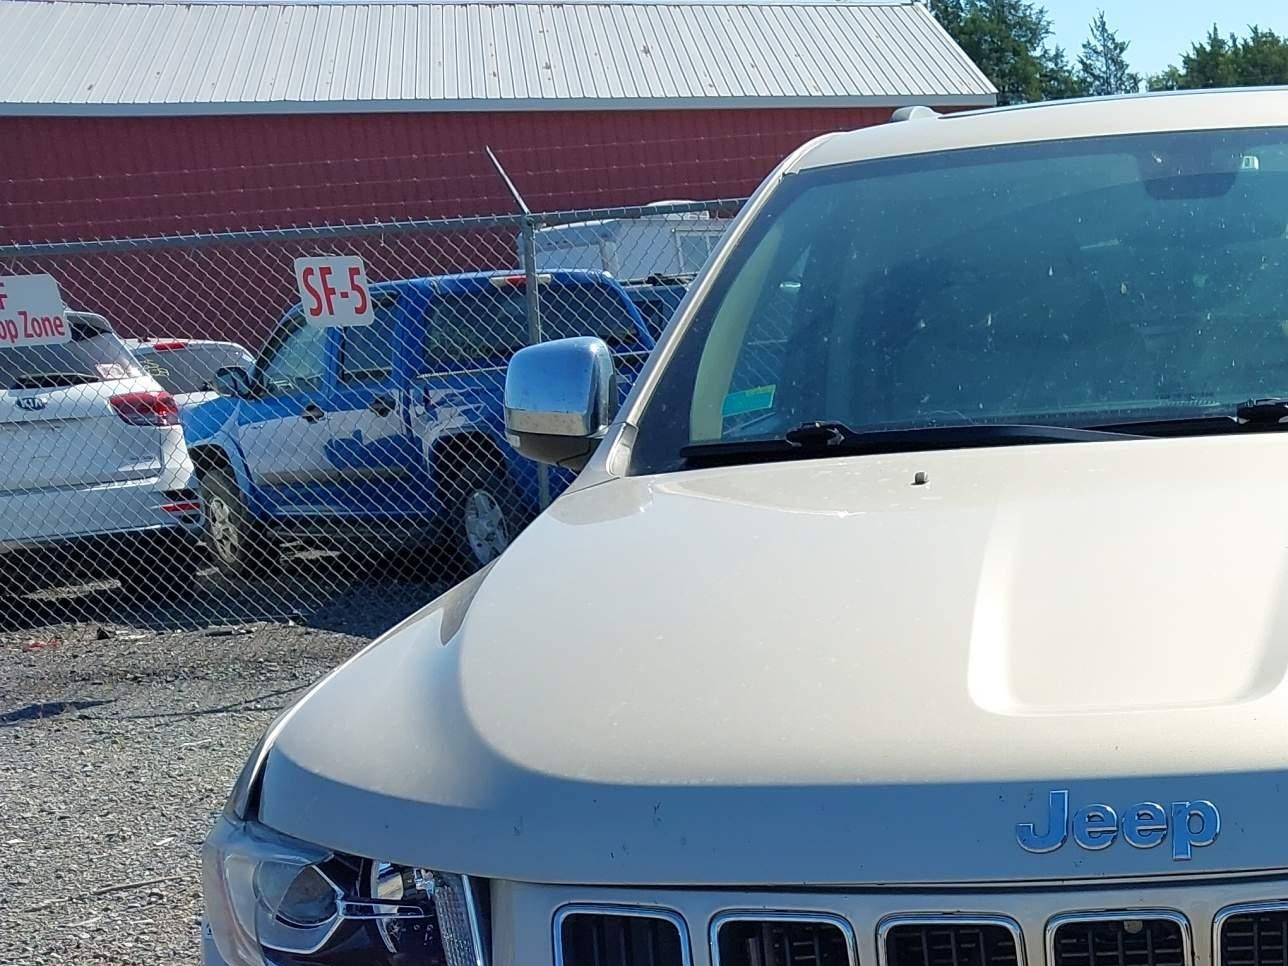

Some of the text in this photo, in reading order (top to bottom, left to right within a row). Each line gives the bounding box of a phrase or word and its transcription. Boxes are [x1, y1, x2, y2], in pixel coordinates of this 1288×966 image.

[302, 266, 367, 317] SF-5
[17, 311, 65, 338] Zone
[1016, 789, 1221, 861] Jeep
